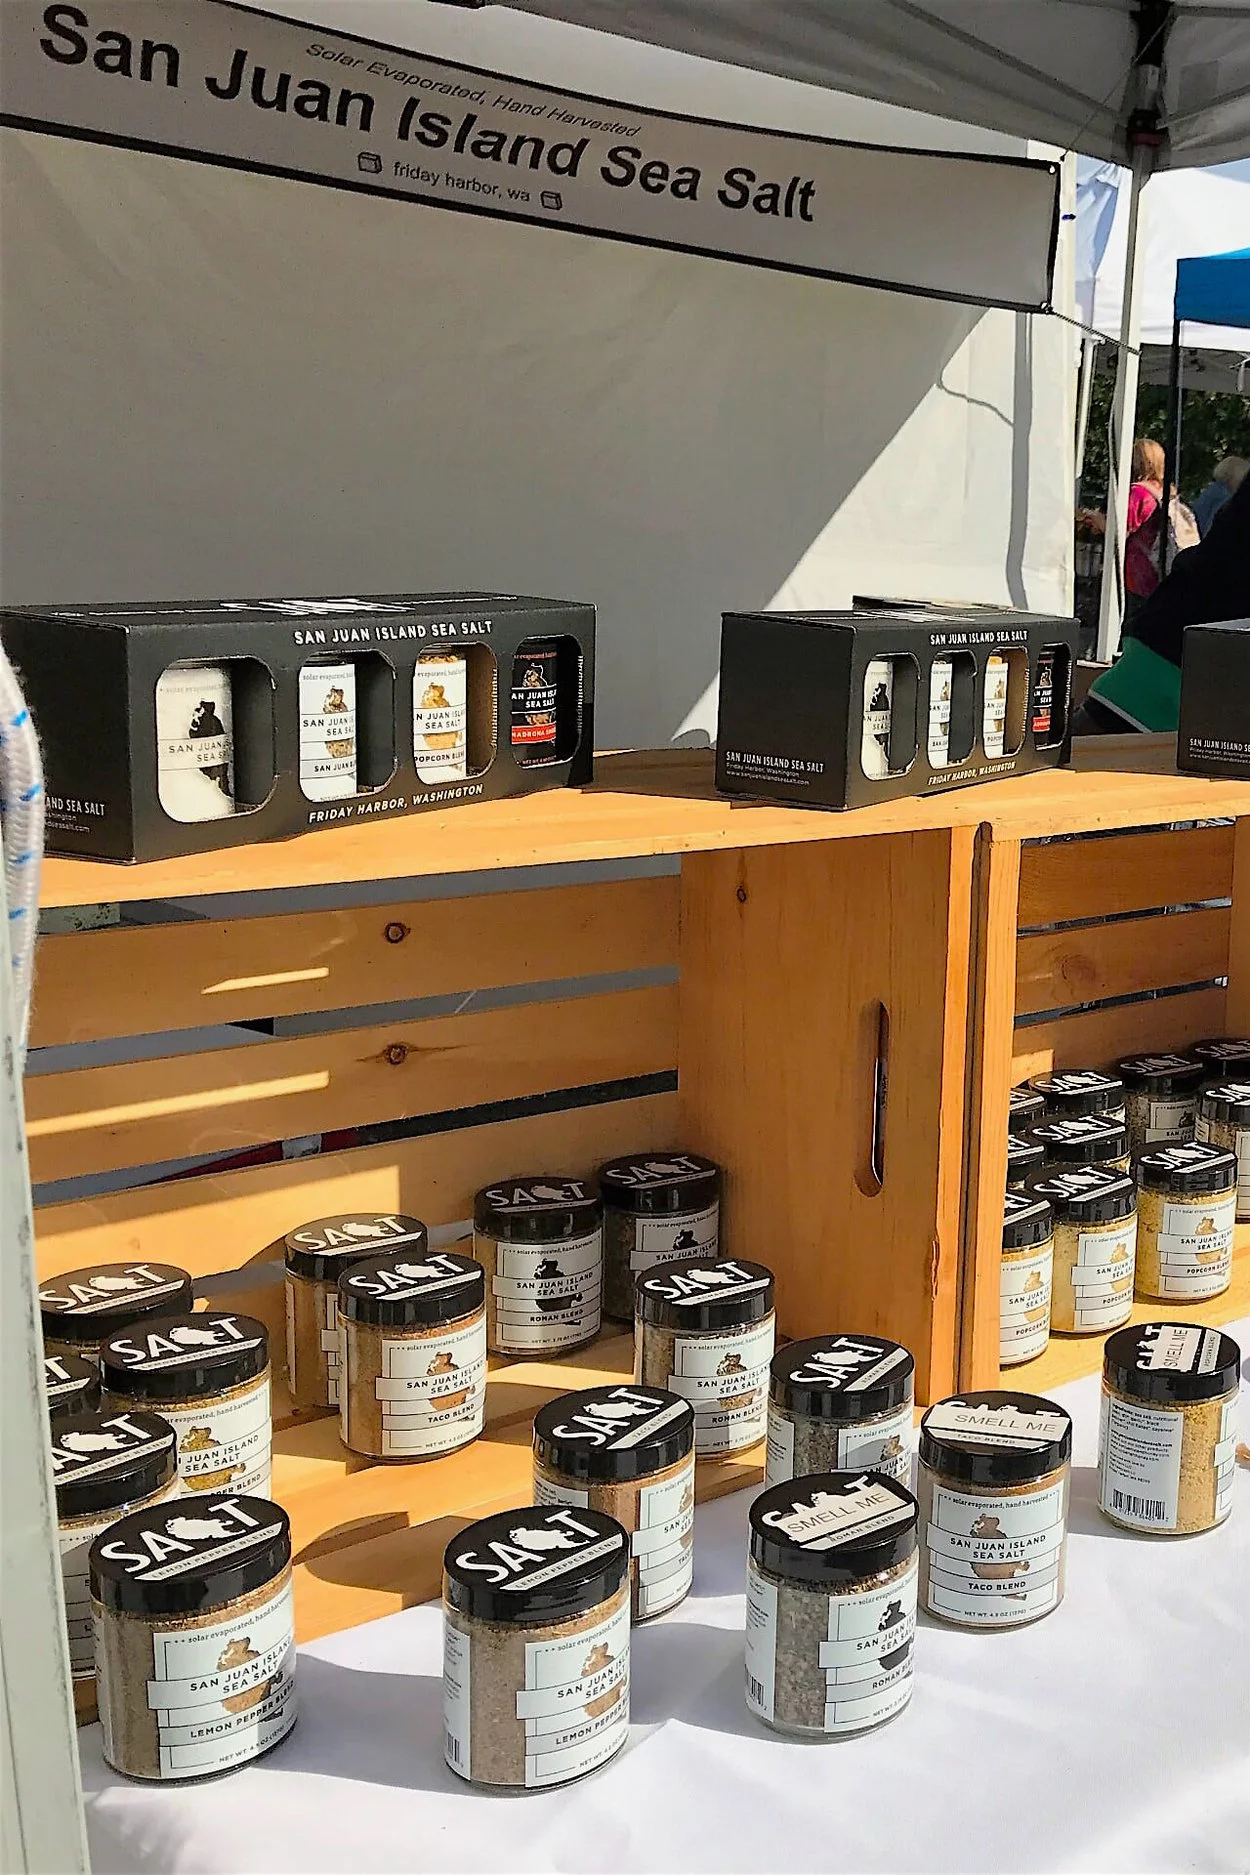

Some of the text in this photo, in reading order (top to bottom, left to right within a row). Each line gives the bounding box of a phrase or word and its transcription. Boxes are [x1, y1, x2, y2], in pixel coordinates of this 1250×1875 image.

[306, 43, 364, 70] Solar
[493, 94, 546, 120] Hand
[548, 105, 642, 139] Harvested
[40, 4, 816, 222] San Juan Island Sea Salt
[393, 160, 531, 203] friday harbor, wa
[294, 620, 493, 645] SAN JUAN ISLAND SEA SALT
[930, 630, 1028, 645] SAN JUAN ISLAND SEA SALT
[303, 719, 324, 727] SAN
[427, 711, 449, 720] JUAN
[327, 728, 343, 736] SEA
[425, 722, 442, 730] SEA
[169, 744, 194, 754] SAN
[1189, 738, 1202, 747] SAN
[1203, 739, 1220, 749] JUAN
[1220, 741, 1243, 751] ISLAND
[414, 754, 450, 763] POPCORN
[726, 751, 824, 773] SAN JUAN ISLAND SEA SALT
[66, 799, 105, 816] SEA SALT
[308, 783, 483, 824] FRIDAY HARBOR, WASHINGTON
[656, 1253, 673, 1261] SAN
[516, 1271, 593, 1289] SAN JUAN ISLAND
[537, 1284, 579, 1296] SEA SALT
[1009, 1297, 1025, 1305] SAN
[530, 1313, 558, 1322] ROMAN
[1163, 1342, 1185, 1367] SMELL
[407, 1373, 458, 1389] SAN JUAN
[430, 1376, 473, 1395] SEA SALT
[697, 1374, 746, 1388] SAN JUAN
[719, 1379, 759, 1395] SEA SALT
[428, 1403, 475, 1423] TACO BLEND
[712, 1412, 741, 1424] ROMAN
[954, 1413, 1057, 1432] SMELL ME
[957, 1433, 981, 1441] TACO
[186, 1434, 259, 1464] JUAN ISLAND
[185, 1452, 240, 1472] SEA SALT
[236, 1473, 262, 1491] BLEND
[787, 1492, 890, 1534] SMELL ME
[952, 1499, 967, 1507] solar
[1005, 1499, 1021, 1509] hand
[664, 1522, 680, 1534] SAN
[829, 1514, 895, 1542] ROMAN BLEND
[950, 1535, 1046, 1551] SAN JUAN ISLAND
[151, 1560, 192, 1578] LEMON
[239, 1528, 275, 1546] BLEND
[973, 1549, 1025, 1560] SEA SALT
[516, 1538, 618, 1588] LEMON PEPPER BLEND
[968, 1581, 1026, 1592] TACO BLEND
[188, 1617, 255, 1644] solar evaporated,
[856, 1625, 905, 1651] SAN JUAN
[557, 1641, 576, 1652] solar
[880, 1640, 898, 1653] SEA
[190, 1662, 259, 1692] SAN JUAN
[223, 1661, 278, 1694] SEA SALT
[557, 1665, 614, 1699] SAN JUAN
[585, 1664, 626, 1699] SEA SALT
[872, 1669, 901, 1690] ROMAN
[190, 1701, 274, 1738] LEMON PEPPER
[555, 1704, 622, 1745] LEMON PEPPER
[218, 1753, 234, 1763] NET
